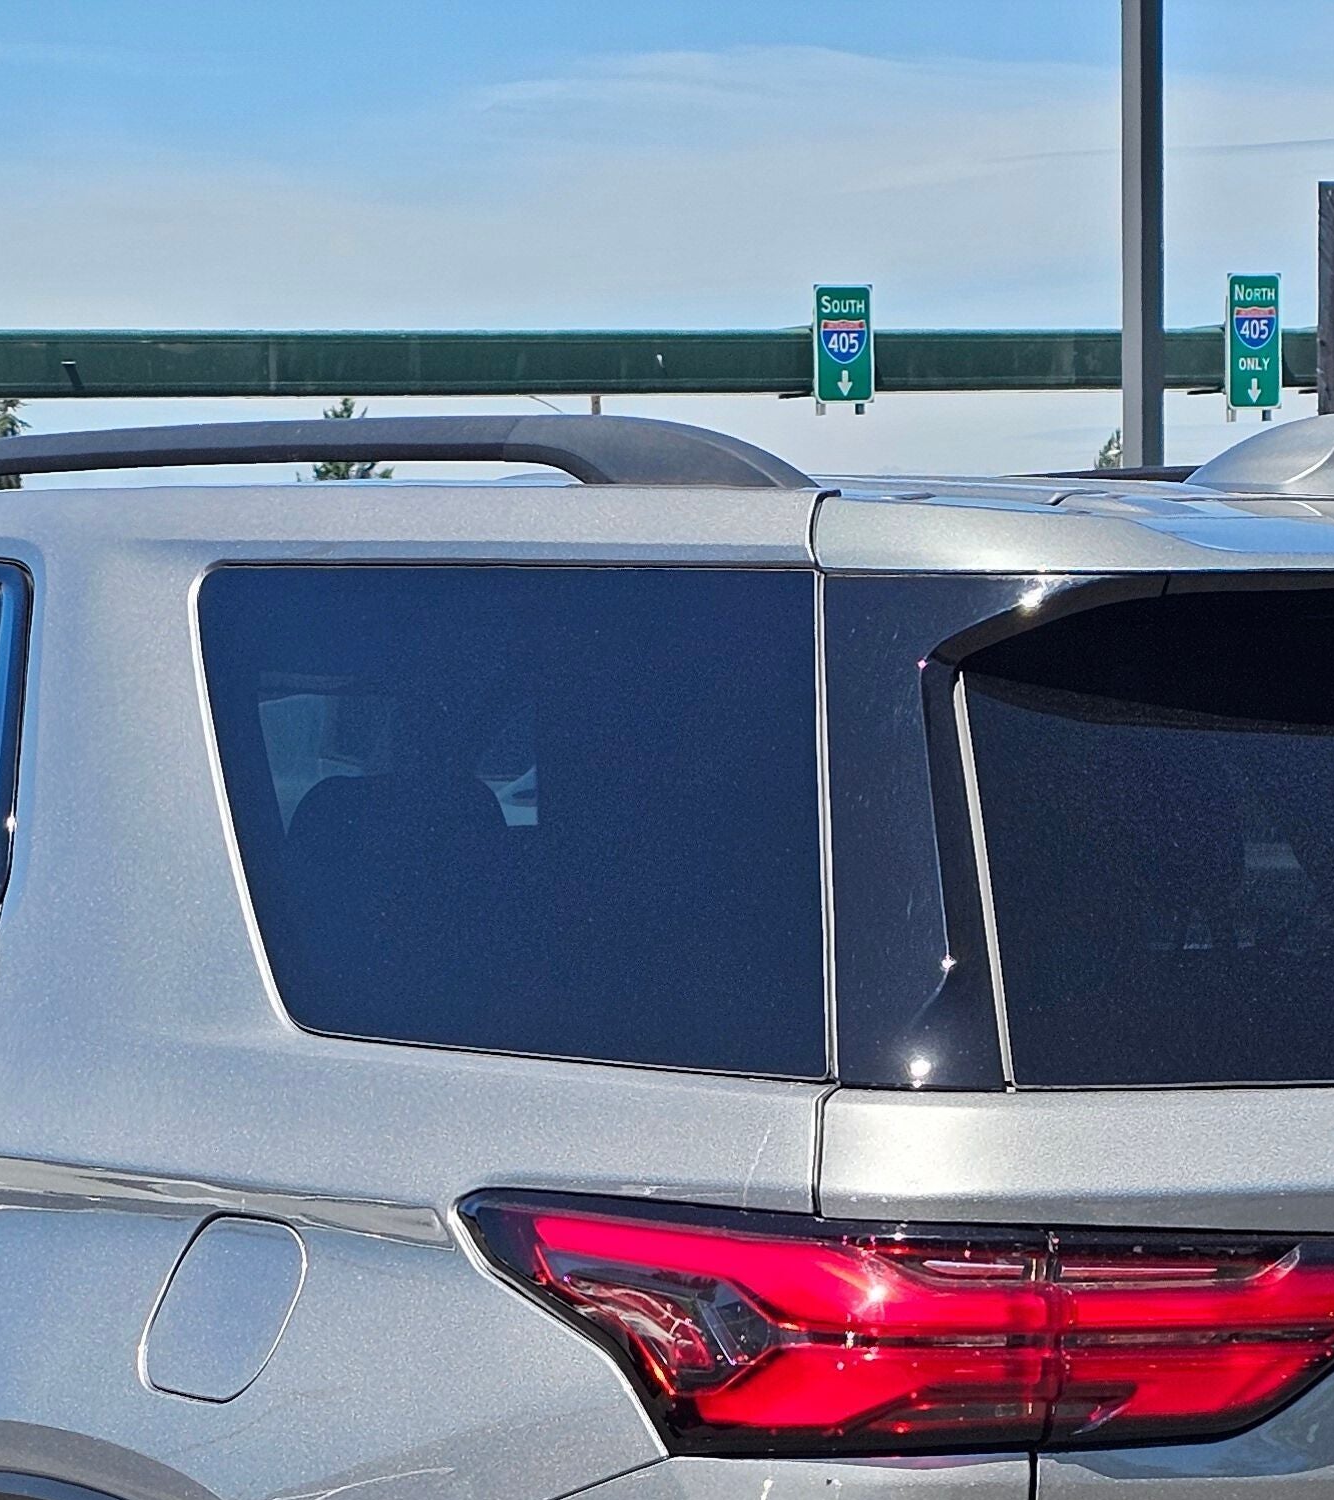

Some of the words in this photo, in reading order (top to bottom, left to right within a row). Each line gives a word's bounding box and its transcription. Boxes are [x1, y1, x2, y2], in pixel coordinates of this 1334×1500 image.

[1234, 284, 1275, 301] NORTH
[821, 295, 865, 313] SOUTH
[1240, 319, 1269, 339] 405
[828, 332, 859, 353] 405
[1238, 357, 1270, 371] ONLY
